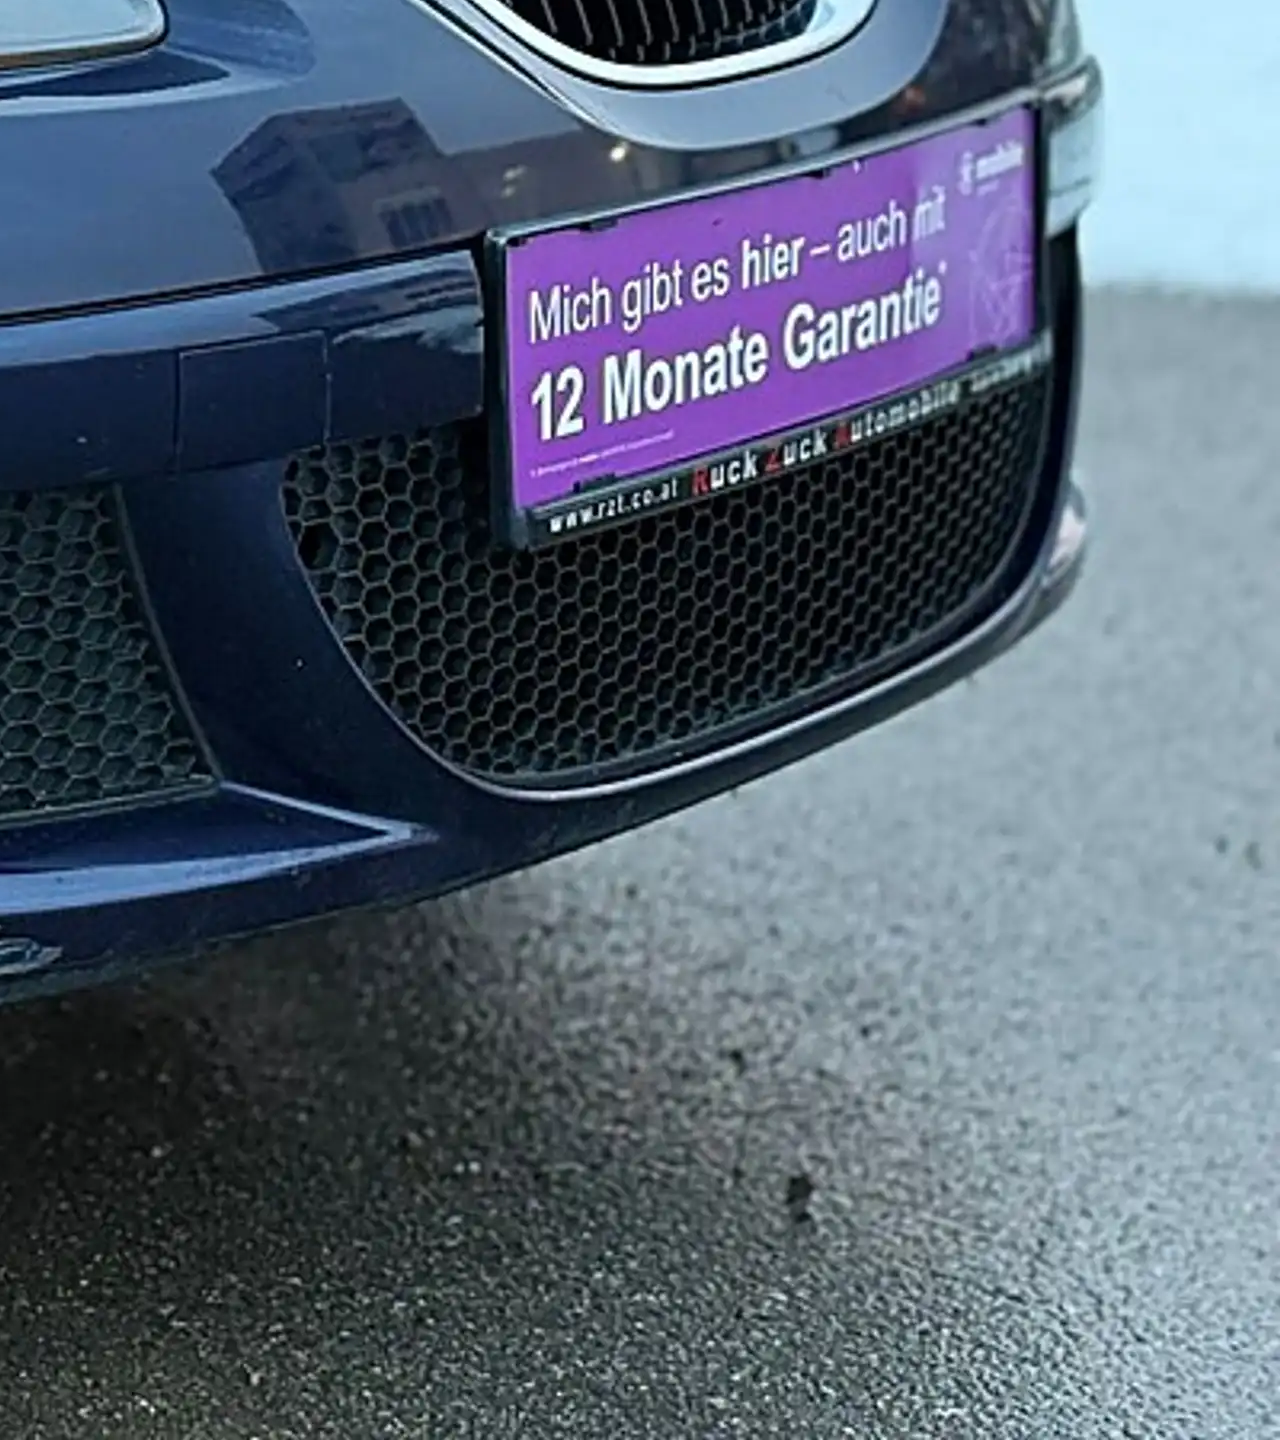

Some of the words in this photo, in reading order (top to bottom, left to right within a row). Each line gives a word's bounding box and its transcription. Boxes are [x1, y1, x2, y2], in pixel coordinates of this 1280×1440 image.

[530, 277, 612, 344] Mich
[622, 259, 683, 332] gibt
[691, 257, 730, 302] es
[742, 233, 805, 289] hier
[838, 198, 907, 262] auch
[913, 184, 946, 242] mit
[531, 366, 586, 441] 12
[603, 325, 769, 425] Monate
[694, 449, 759, 497] Ruck
